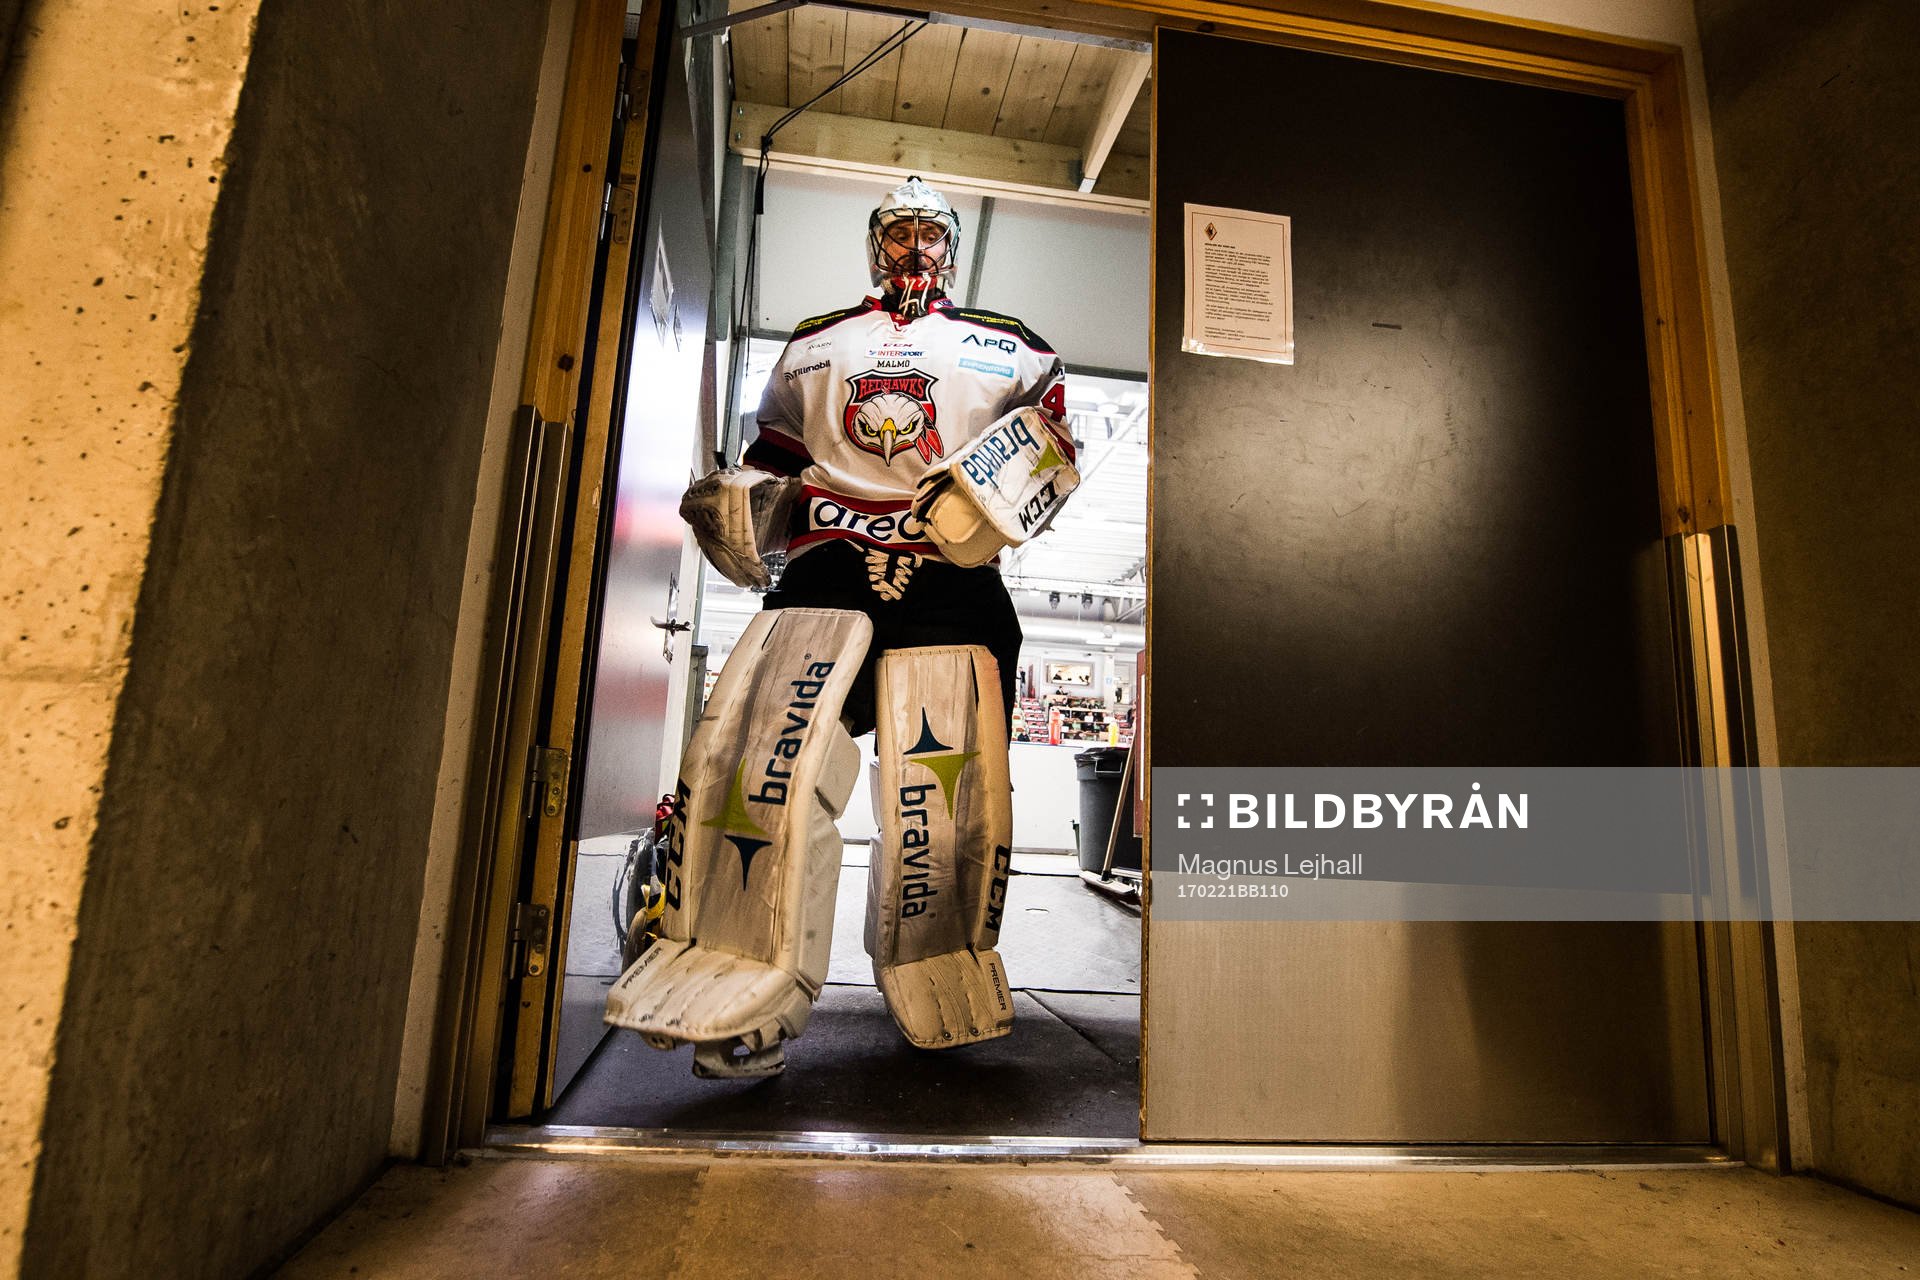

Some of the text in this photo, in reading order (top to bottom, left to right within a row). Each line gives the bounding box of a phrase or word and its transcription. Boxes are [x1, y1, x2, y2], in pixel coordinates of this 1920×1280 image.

[961, 334, 1018, 355] APQ
[858, 378, 925, 400] REDHAWKS
[1018, 481, 1059, 533] CCM
[748, 661, 836, 806] bravida
[665, 777, 691, 912] CCM
[900, 784, 938, 919] bravida
[985, 844, 1010, 932] CCM
[989, 962, 1007, 1011] PREMIER
